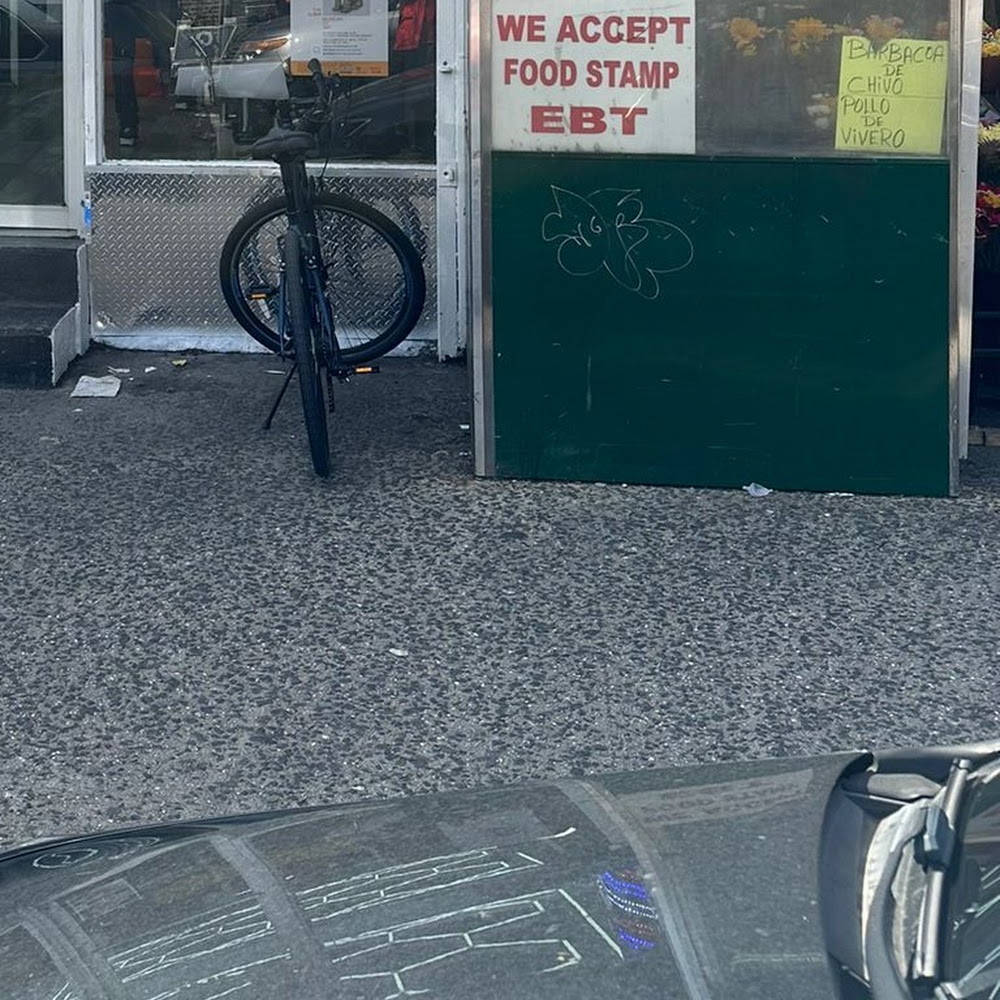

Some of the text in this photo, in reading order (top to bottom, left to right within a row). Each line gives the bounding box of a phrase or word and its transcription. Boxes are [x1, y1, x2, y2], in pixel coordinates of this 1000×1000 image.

[496, 14, 691, 44] WE ACCEPT
[504, 58, 680, 89] FOOD STAMP
[883, 64, 905, 77] DE
[841, 95, 891, 115] POLLO
[530, 105, 648, 135] EBT
[861, 115, 884, 127] DE
